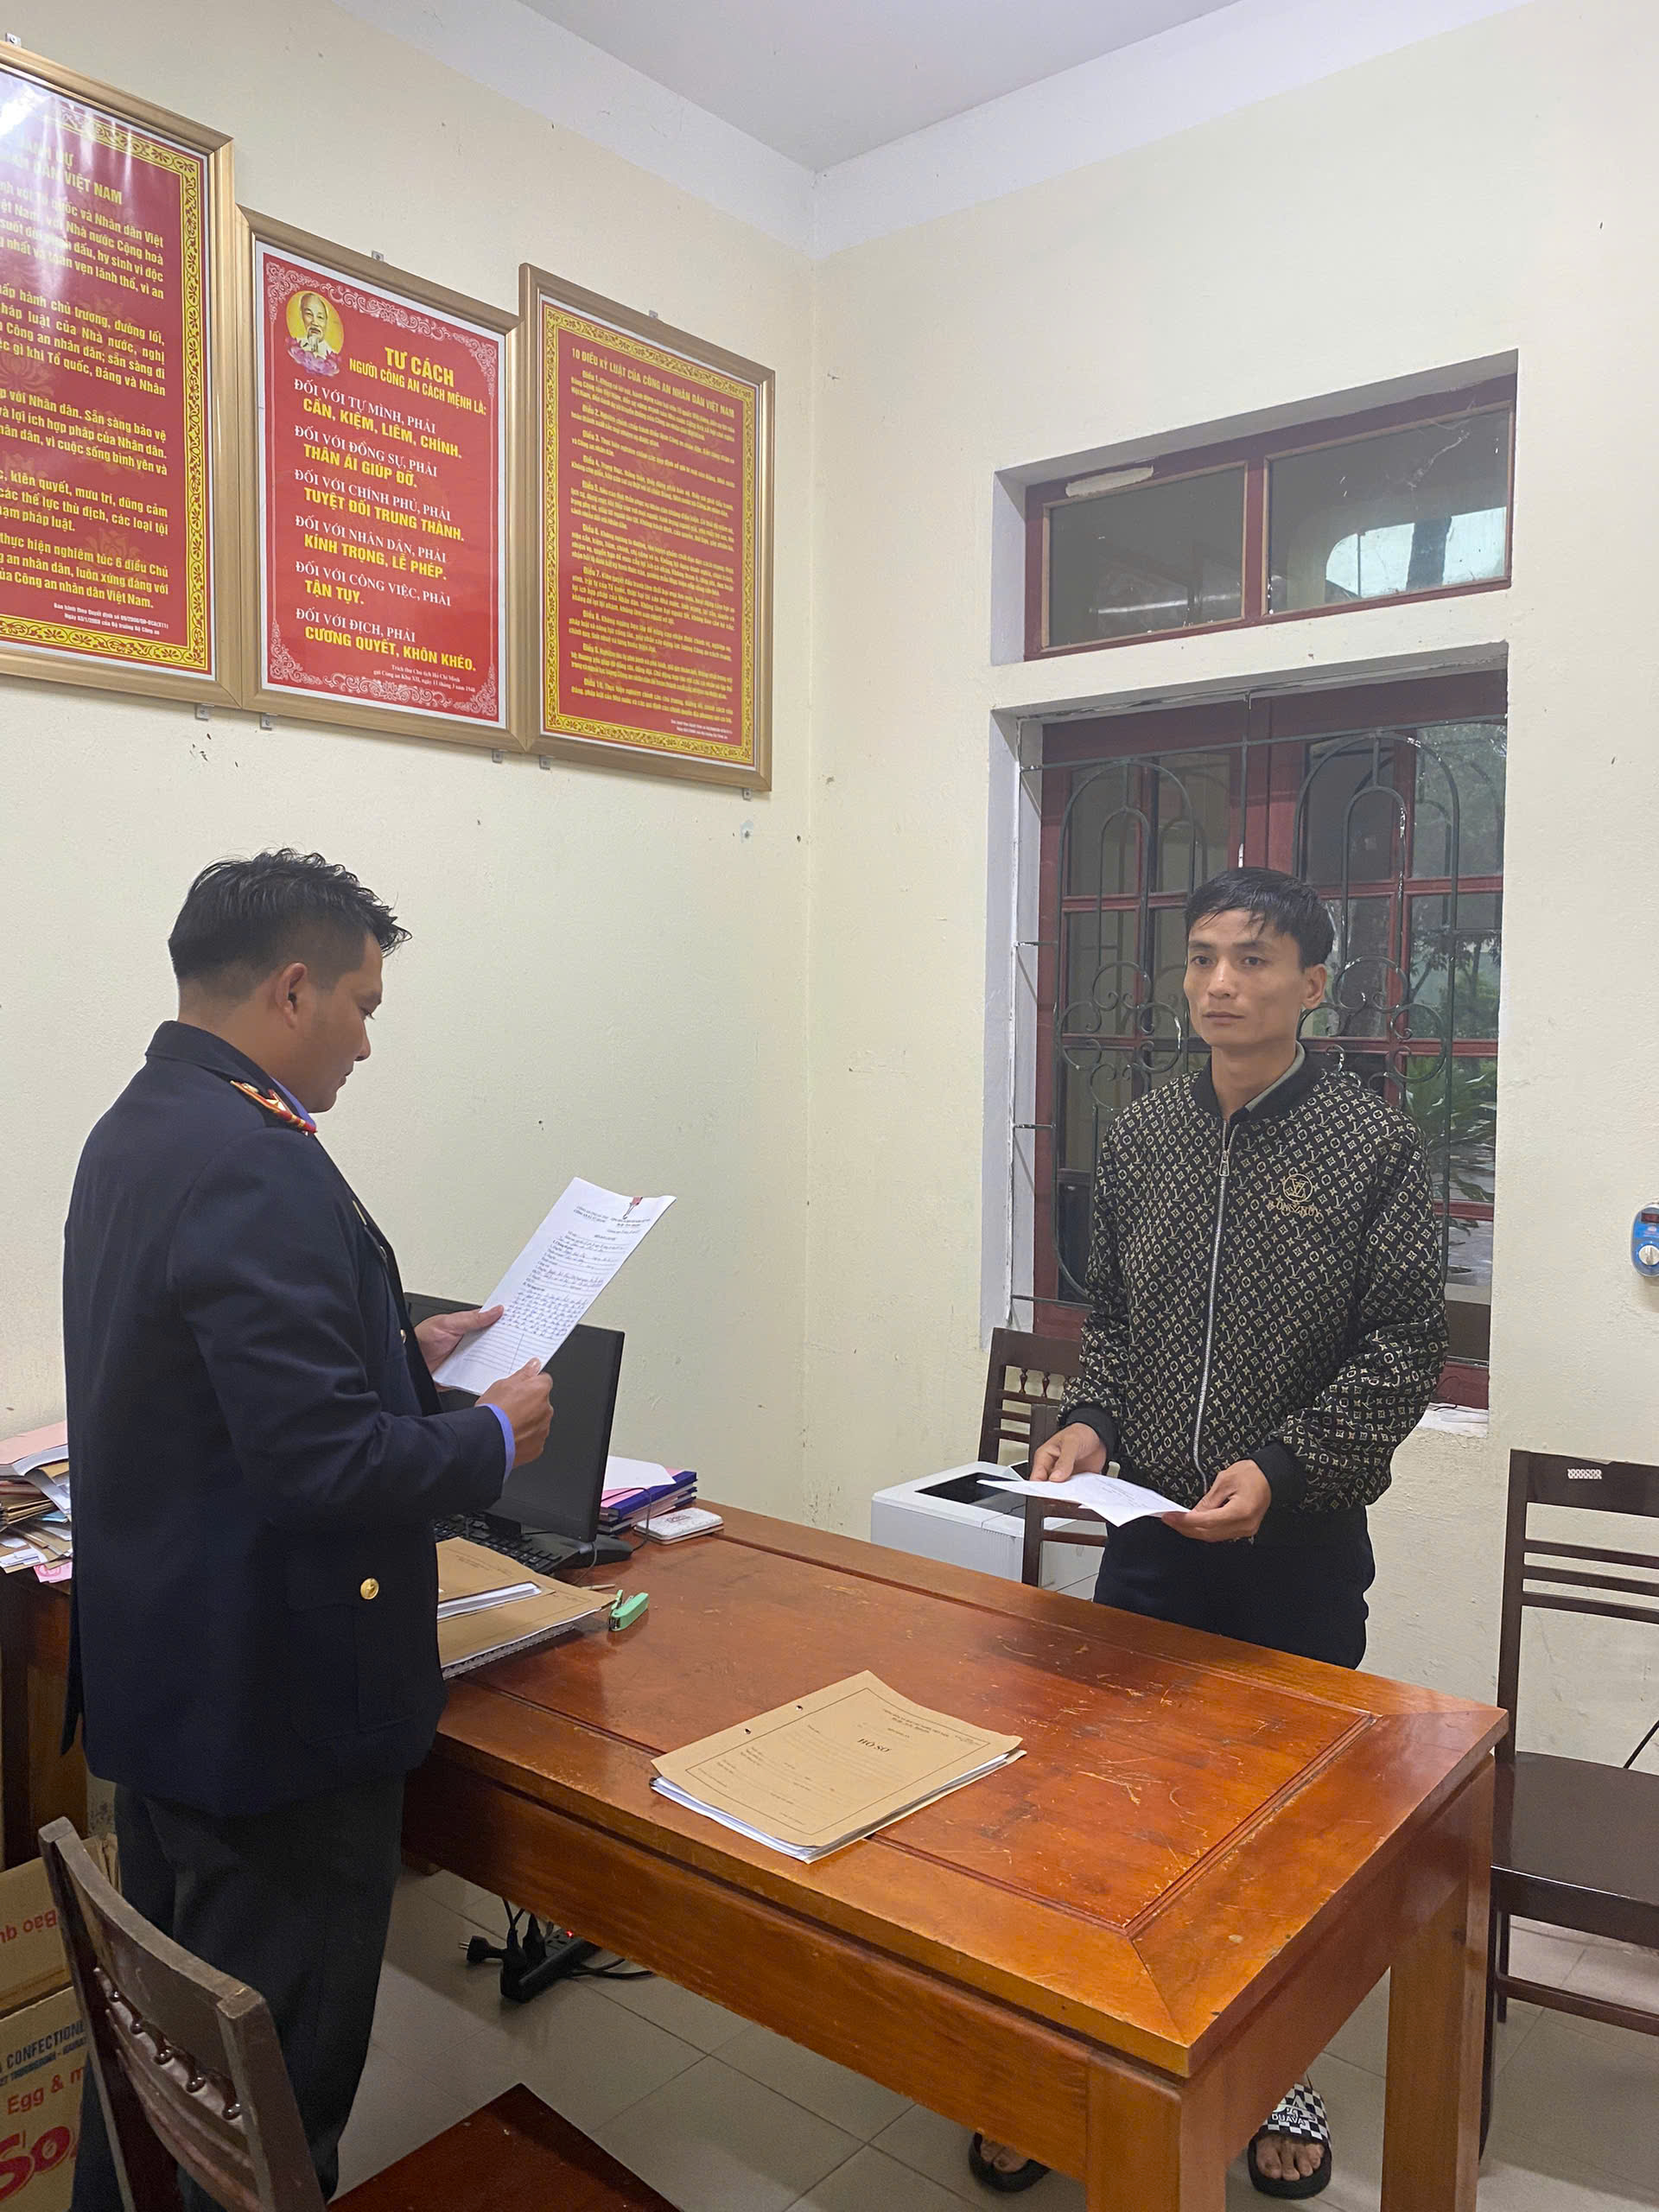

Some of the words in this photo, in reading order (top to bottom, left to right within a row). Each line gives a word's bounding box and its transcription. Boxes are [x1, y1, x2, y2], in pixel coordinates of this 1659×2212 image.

[65, 171, 91, 193] VIỆT
[94, 182, 122, 205] NAM
[13, 344, 23, 355] gì
[27, 346, 44, 361] khi
[48, 352, 60, 365] Tổ
[63, 359, 92, 377] quốc,
[95, 365, 122, 385] Đảng
[124, 376, 137, 388] và
[139, 378, 166, 397] Nhân
[349, 358, 378, 379] NGƯỜI
[380, 369, 405, 388] CÔNG
[407, 378, 420, 393] AN
[422, 383, 445, 402] CÁCH
[447, 391, 472, 410] MỆNH
[474, 400, 486, 416] LÀ:
[385, 346, 408, 370] TƯ
[411, 356, 454, 387] CÁCH
[10, 391, 26, 404] với
[29, 394, 57, 412] Nhân
[60, 404, 82, 419] dân.
[85, 410, 105, 425] Sẵn
[107, 417, 131, 434] sàng
[154, 429, 166, 443] vệ
[295, 378, 318, 397] ĐỐI
[321, 387, 345, 405] VỚI
[348, 396, 366, 414] TỰ
[368, 403, 404, 425] MÌNH,
[407, 416, 435, 434] PHẢI
[303, 398, 335, 421] CẦN,
[340, 410, 378, 434] KIỆM,
[382, 423, 416, 446] LIÊM,
[420, 435, 462, 459] CHÍNH.
[11, 408, 25, 423] lợi
[28, 412, 45, 428] ích
[47, 417, 67, 434] hợp
[68, 425, 94, 441] pháp
[97, 431, 116, 446] của
[118, 435, 144, 453] Nhân
[145, 444, 167, 459] dân.
[20, 429, 43, 446] dân,
[57, 440, 84, 454] cuộc
[86, 445, 111, 462] sống
[112, 451, 135, 467] bình
[137, 459, 154, 473] yên
[156, 464, 167, 475] và
[295, 425, 319, 442] ĐỐI
[322, 433, 346, 450] VỚI
[349, 442, 385, 461] ĐỒNG
[388, 454, 407, 472] SỰ,
[410, 459, 436, 477] PHẢI
[303, 443, 340, 466] THÂN
[344, 454, 357, 471] ÁI
[361, 461, 392, 480] GIÚP
[396, 470, 417, 487] ĐỠ.
[10, 470, 35, 486] kiên
[39, 479, 73, 496] quyết,
[75, 487, 99, 501] mưu
[118, 497, 143, 513] dũng
[146, 503, 168, 518] cảm
[22, 492, 40, 505] thế
[42, 496, 60, 511] lực
[82, 505, 109, 523] địch,
[111, 513, 130, 526] các
[133, 517, 152, 533] loại
[156, 523, 168, 537] tội
[295, 469, 318, 486] ĐỐI
[322, 476, 345, 493] VỚI
[348, 485, 389, 505] CHÍNH
[393, 496, 420, 514] PHỦ,
[423, 504, 450, 521] PHẢI
[304, 486, 345, 510] TUYỆT
[348, 499, 371, 517] ĐỐI
[374, 506, 417, 529] TRUNG
[421, 518, 464, 541] THÀNH.
[22, 511, 49, 526] pháp
[51, 515, 75, 532] luật.
[296, 515, 319, 531] ĐỐI
[323, 522, 345, 538] VỚI
[349, 529, 383, 547] NHÂN
[387, 538, 415, 556] DÂN,
[418, 546, 446, 563] PHẢI
[6, 554, 20, 565] an
[22, 556, 48, 571] nhân
[51, 562, 73, 577] dân,
[76, 567, 99, 582] luôn
[100, 573, 125, 588] xứng
[128, 577, 152, 593] đáng
[154, 583, 168, 594] với
[27, 537, 51, 554] hiện
[54, 545, 93, 563] nghiêm
[116, 556, 122, 568] 6
[124, 559, 147, 573] điều
[149, 563, 168, 578] Chủ
[304, 533, 337, 554] KÍNH
[341, 543, 388, 568] TRỌNG,
[392, 553, 406, 570] LỄ
[410, 560, 447, 581] PHÉP.
[15, 571, 42, 588] Công
[44, 579, 57, 590] an
[59, 581, 85, 595] nhân
[86, 586, 105, 600] dân
[106, 589, 126, 605] Việt
[127, 594, 154, 608] Nam.
[296, 561, 319, 576] ĐỐI
[323, 567, 346, 582] VỚI
[349, 574, 385, 591] CÔNG
[388, 582, 420, 601] VIỆC,
[423, 590, 450, 607] PHẢI
[305, 579, 332, 598] TẬN
[335, 587, 364, 605] TỤY.
[296, 608, 320, 623] ĐỐI
[323, 613, 346, 628] VỚI
[349, 619, 384, 637] ĐỊCH,
[387, 626, 415, 643] PHẢI
[305, 626, 352, 647] CƯƠNG
[356, 636, 399, 658] QUYẾT,
[404, 645, 437, 664] KHÔN
[441, 653, 476, 671] KHÉO.
[7, 2087, 44, 2115] Egg
[51, 2074, 64, 2094] &
